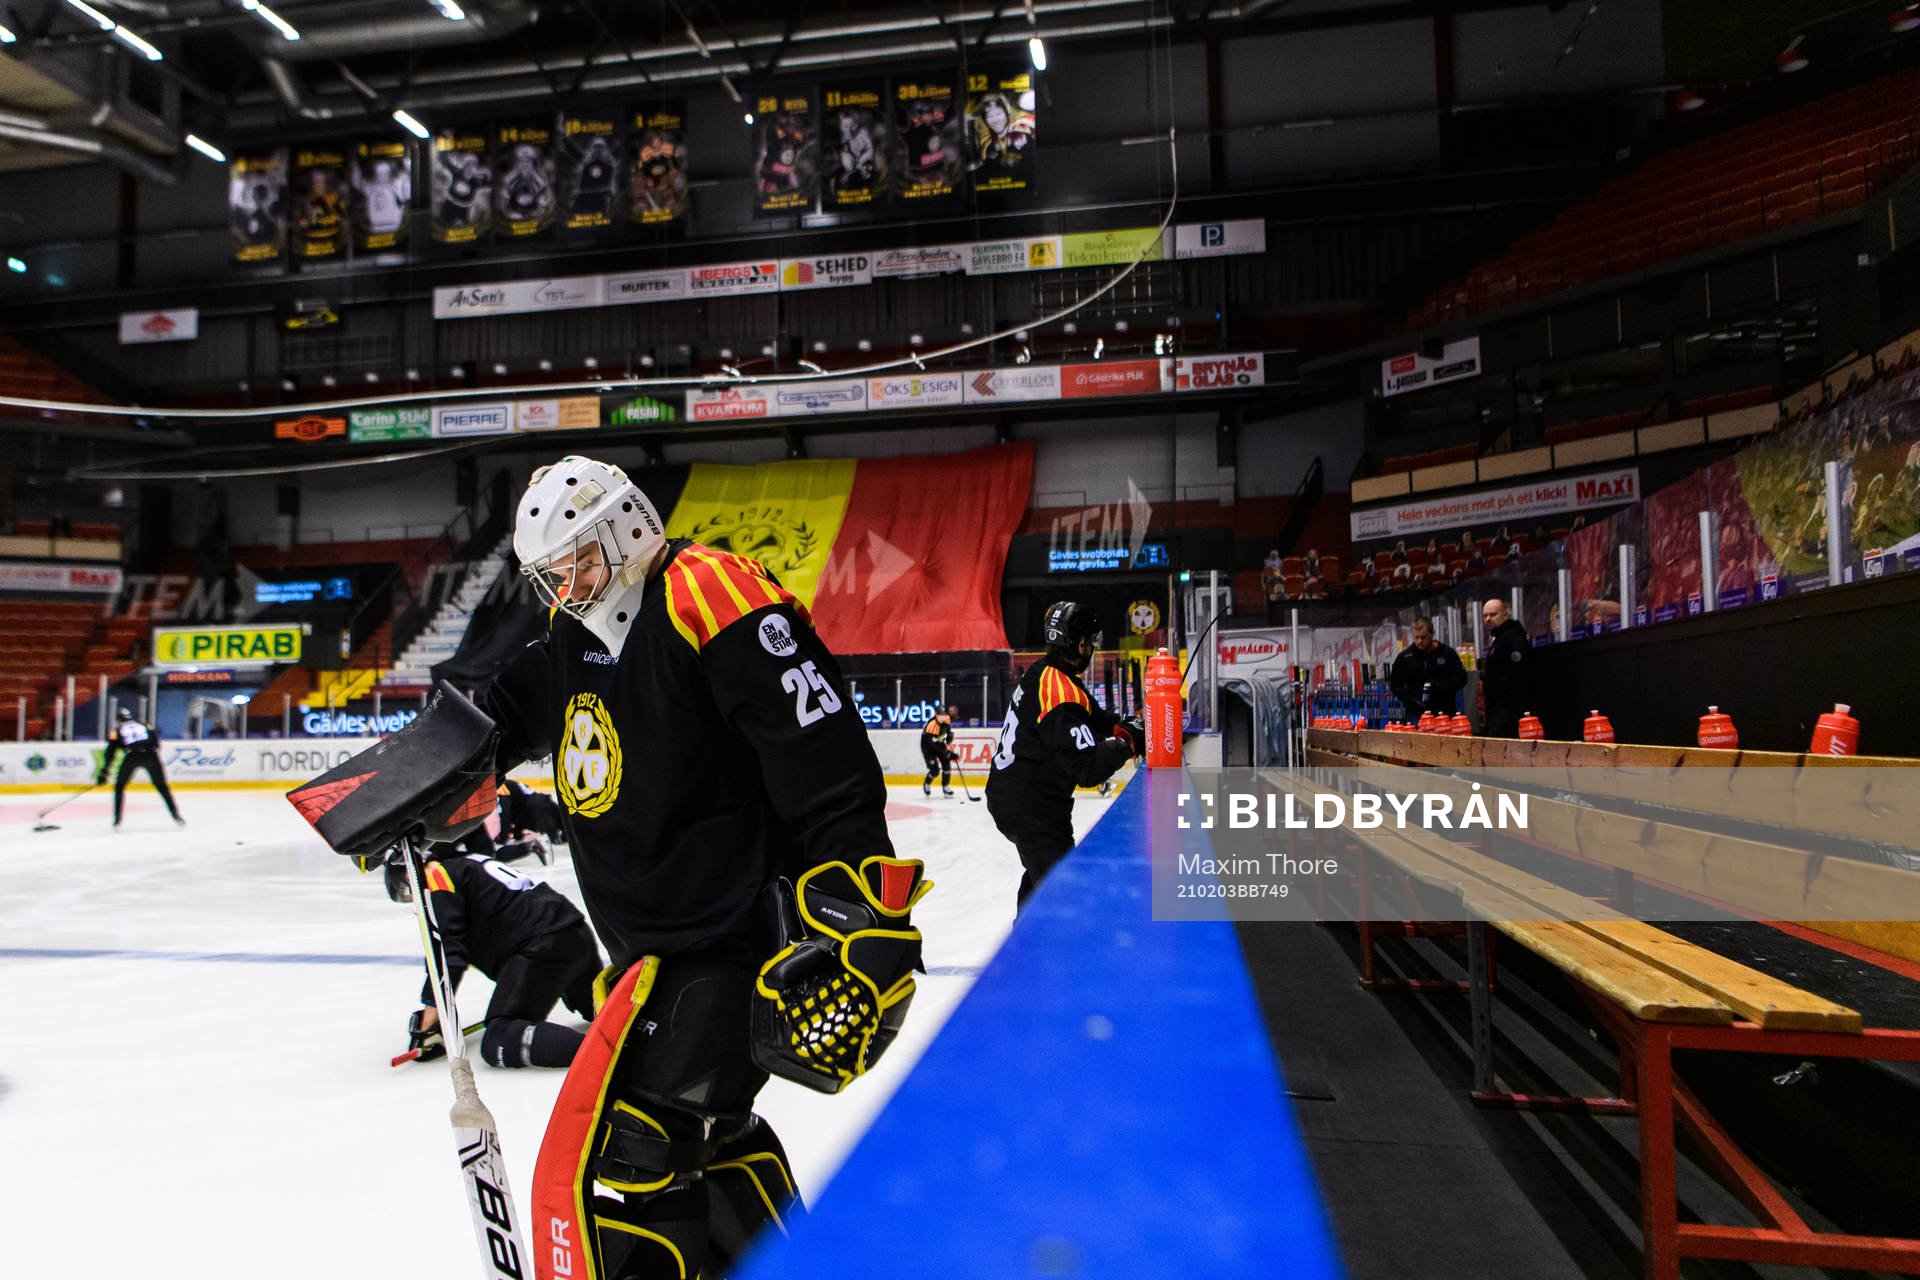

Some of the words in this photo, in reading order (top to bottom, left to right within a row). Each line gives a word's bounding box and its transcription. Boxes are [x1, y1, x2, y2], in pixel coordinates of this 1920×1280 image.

[968, 75, 988, 92] 12
[816, 257, 868, 275] SEHED
[443, 413, 502, 427] PIERRE
[1575, 477, 1634, 500] MAXI
[1425, 502, 1470, 517] veckans
[1536, 485, 1567, 501] klick!
[630, 494, 661, 536] BAUER
[762, 623, 776, 634] EN
[767, 629, 785, 642] BRA
[193, 633, 294, 659] PIRAB
[1237, 642, 1274, 655] MÅLERI
[576, 692, 597, 709] 1912
[781, 660, 842, 728] 25
[303, 711, 367, 734] Gävles
[580, 721, 587, 740] B
[1069, 724, 1096, 750] 20
[591, 761, 599, 778] F
